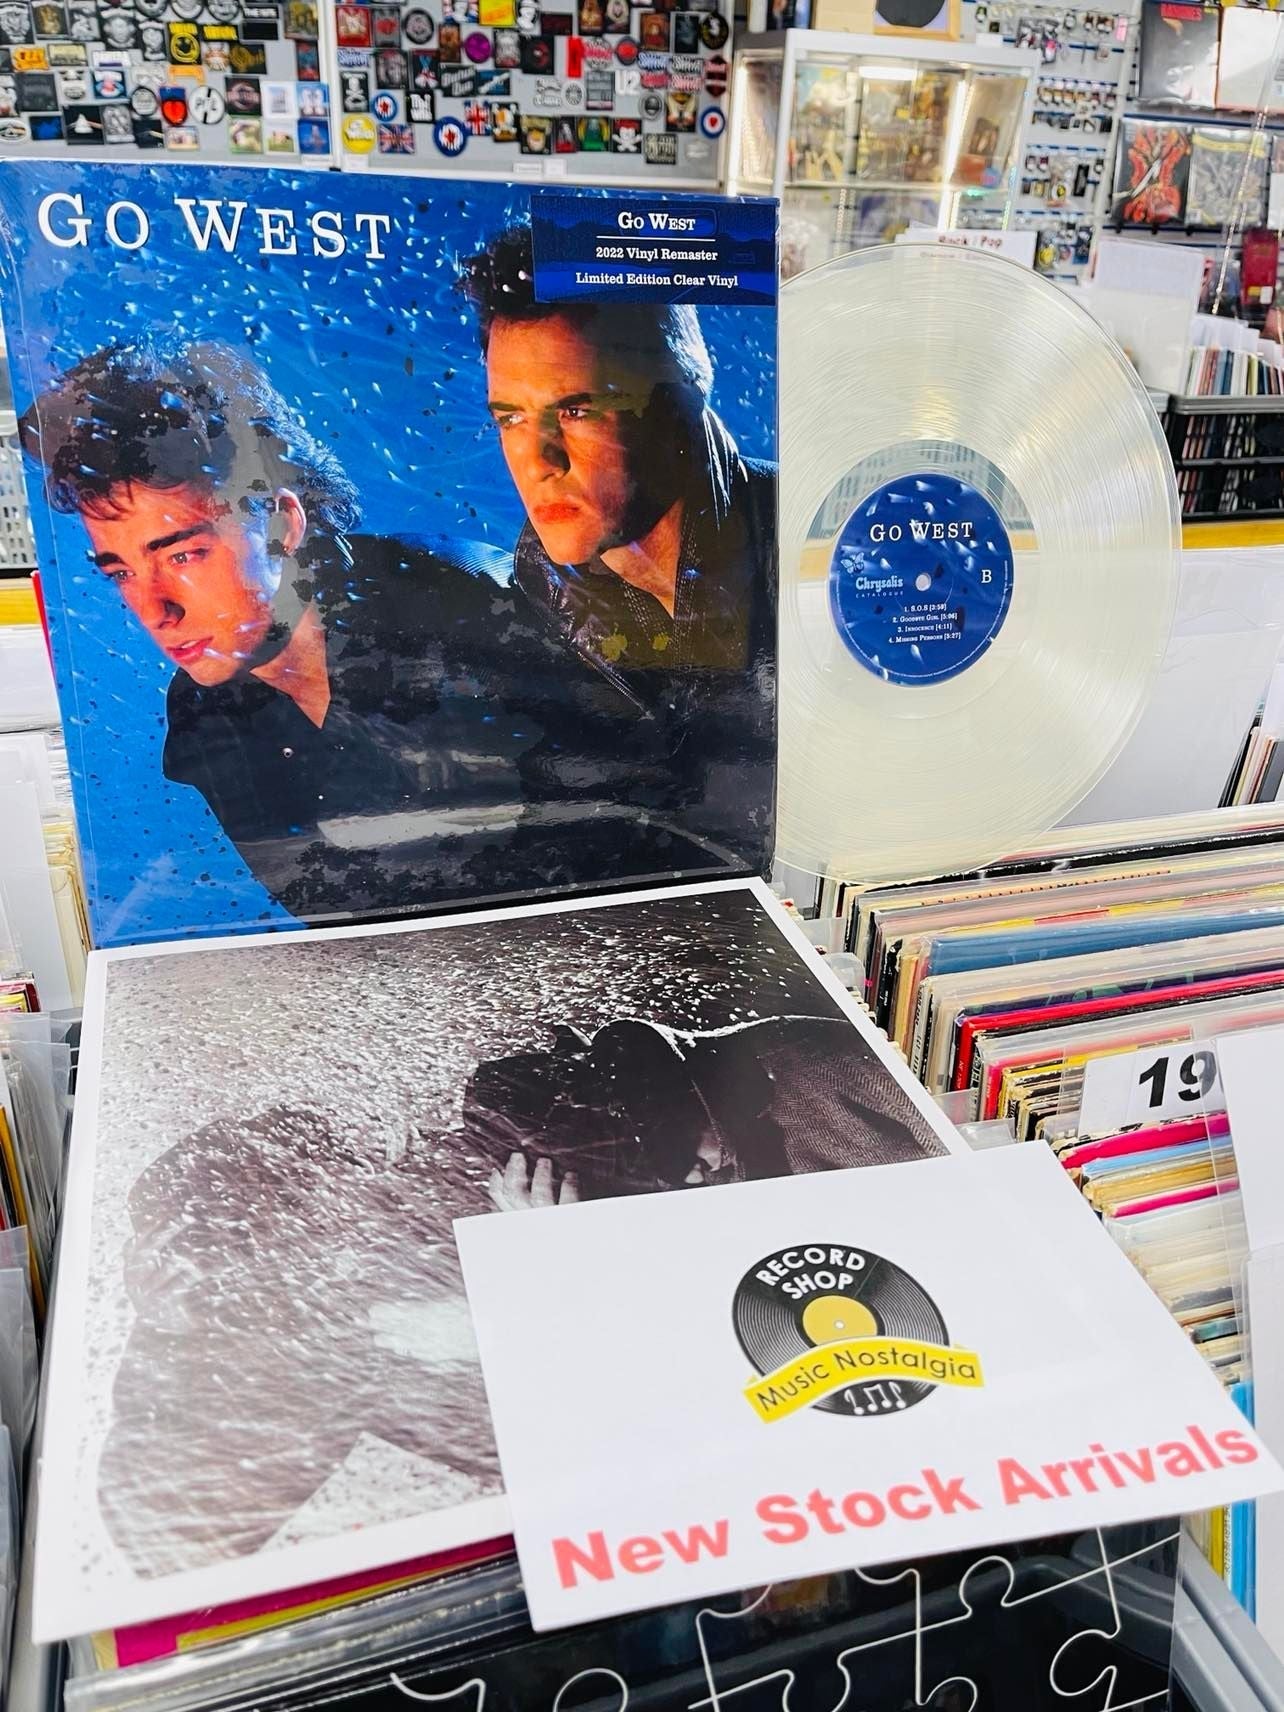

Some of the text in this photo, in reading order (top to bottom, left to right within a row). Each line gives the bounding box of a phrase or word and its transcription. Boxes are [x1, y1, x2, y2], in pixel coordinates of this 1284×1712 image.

[614, 70, 641, 96] U2
[37, 192, 392, 260] GO WEST
[617, 211, 696, 231] GO WEST
[595, 247, 718, 263] 2022 Vinyl Remaster
[575, 272, 738, 289] Limited Edition Clear Vinyl
[870, 521, 973, 542] GO WEST
[855, 575, 904, 593] Chrysalis
[981, 569, 992, 584] B
[855, 590, 904, 599] CATALOGUE
[1139, 1050, 1225, 1108] 19
[755, 1247, 866, 1286] RECORD
[781, 1270, 854, 1300] SHOP
[756, 1347, 976, 1412] Music Nostalgia
[551, 1426, 1259, 1590] New Stock Arrivals
